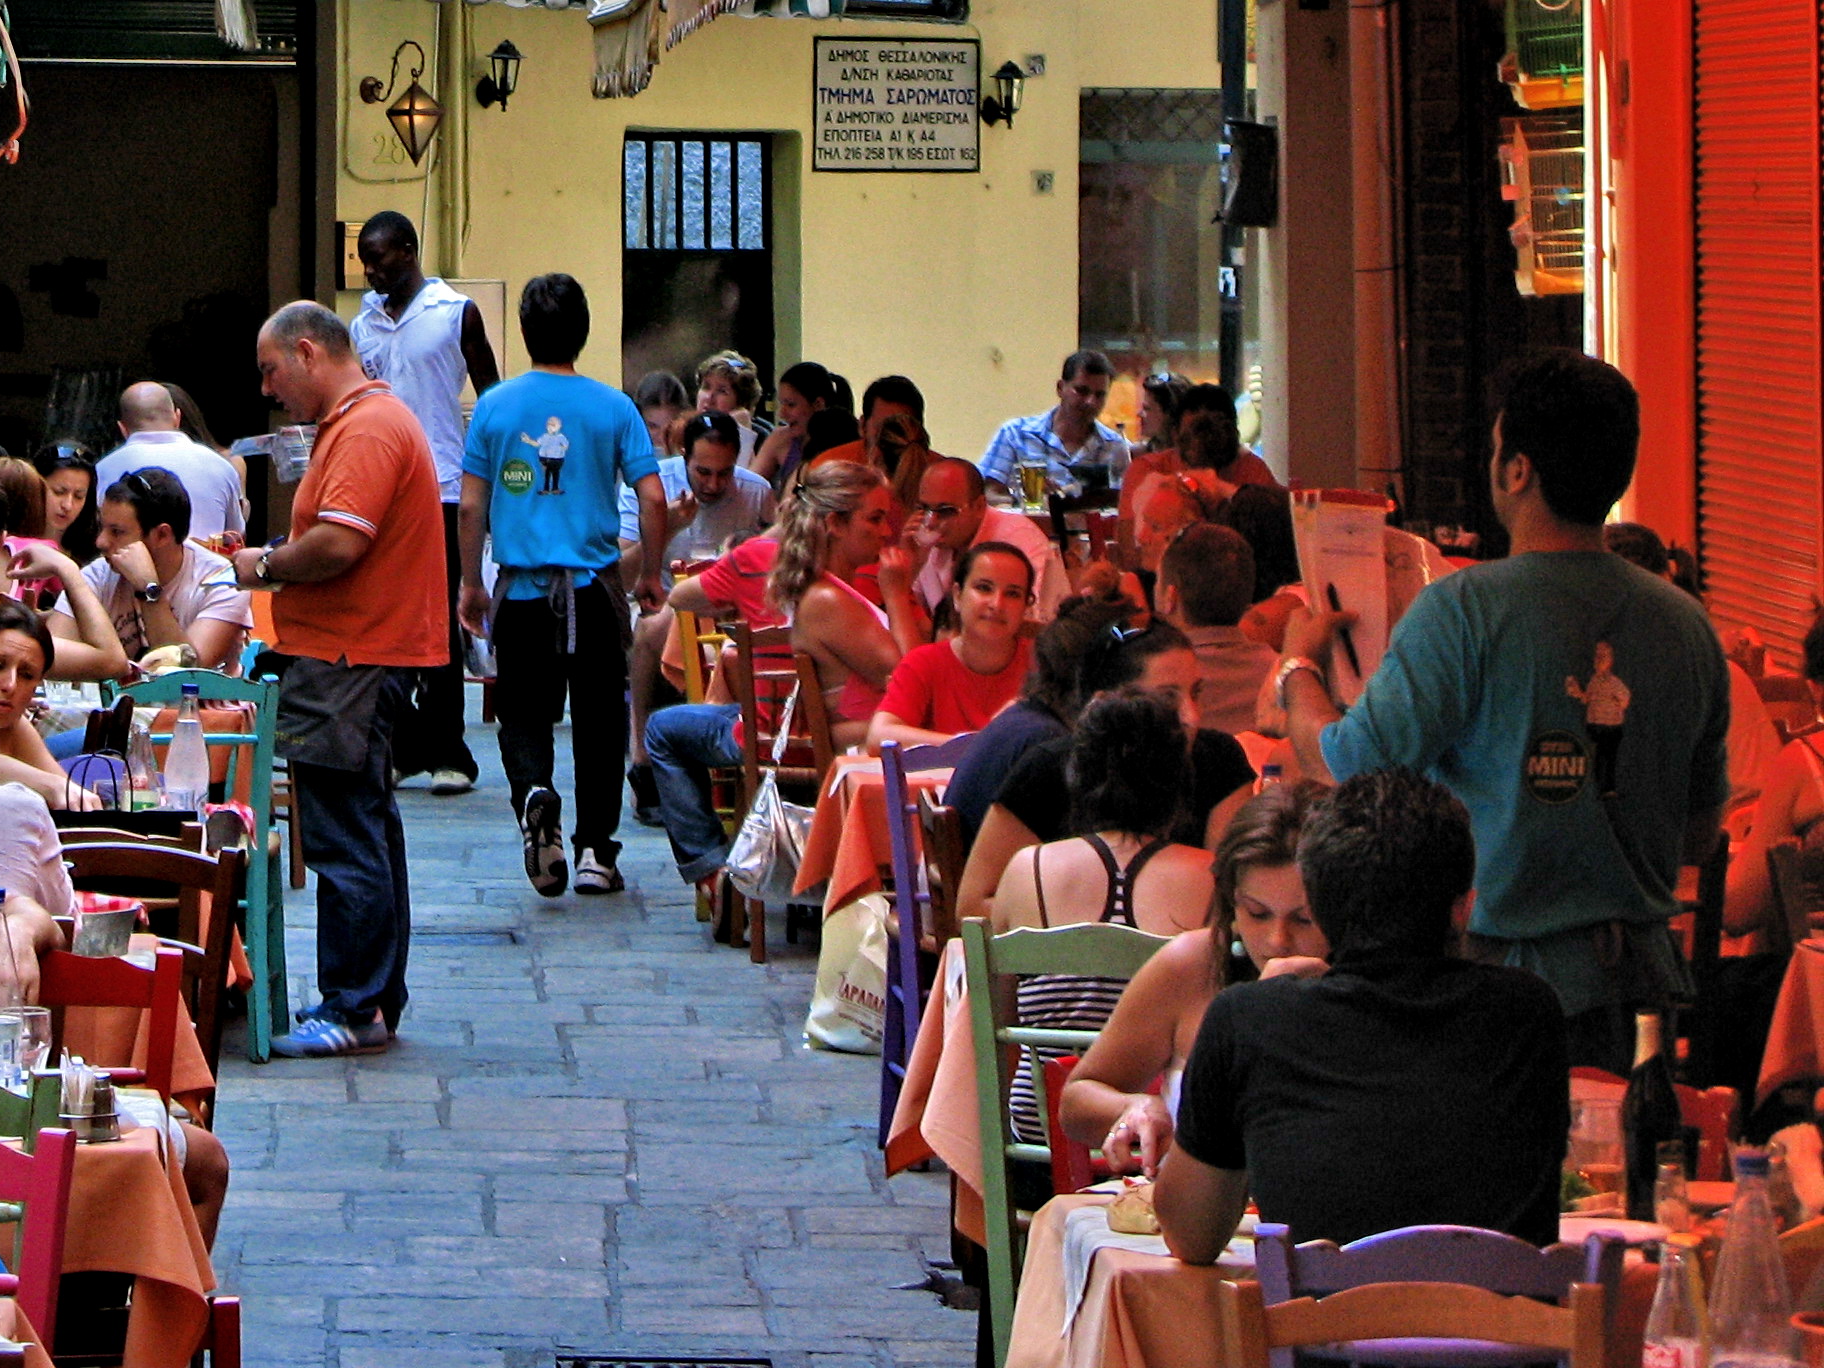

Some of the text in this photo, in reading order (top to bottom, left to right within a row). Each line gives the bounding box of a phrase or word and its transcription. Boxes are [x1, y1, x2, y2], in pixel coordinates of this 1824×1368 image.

[828, 49, 968, 64] ΔΗΜΟΣ ΘΕΣΣΑΛΟΝΙΚΗΣ
[841, 67, 879, 82] Δ/ΝΣΗ
[819, 87, 976, 105] ΤΜΗΜΑ ΣΑΡΩΜΑΤΟΣ
[837, 111, 895, 124] ΔΗΜΟΤΙΚΟ
[902, 112, 970, 125] ΔΙΑΜΕΡΙΣΜΑ
[824, 129, 882, 142] ΕΠΟΠΤΕΙΑ
[1528, 756, 1585, 777] MINI
